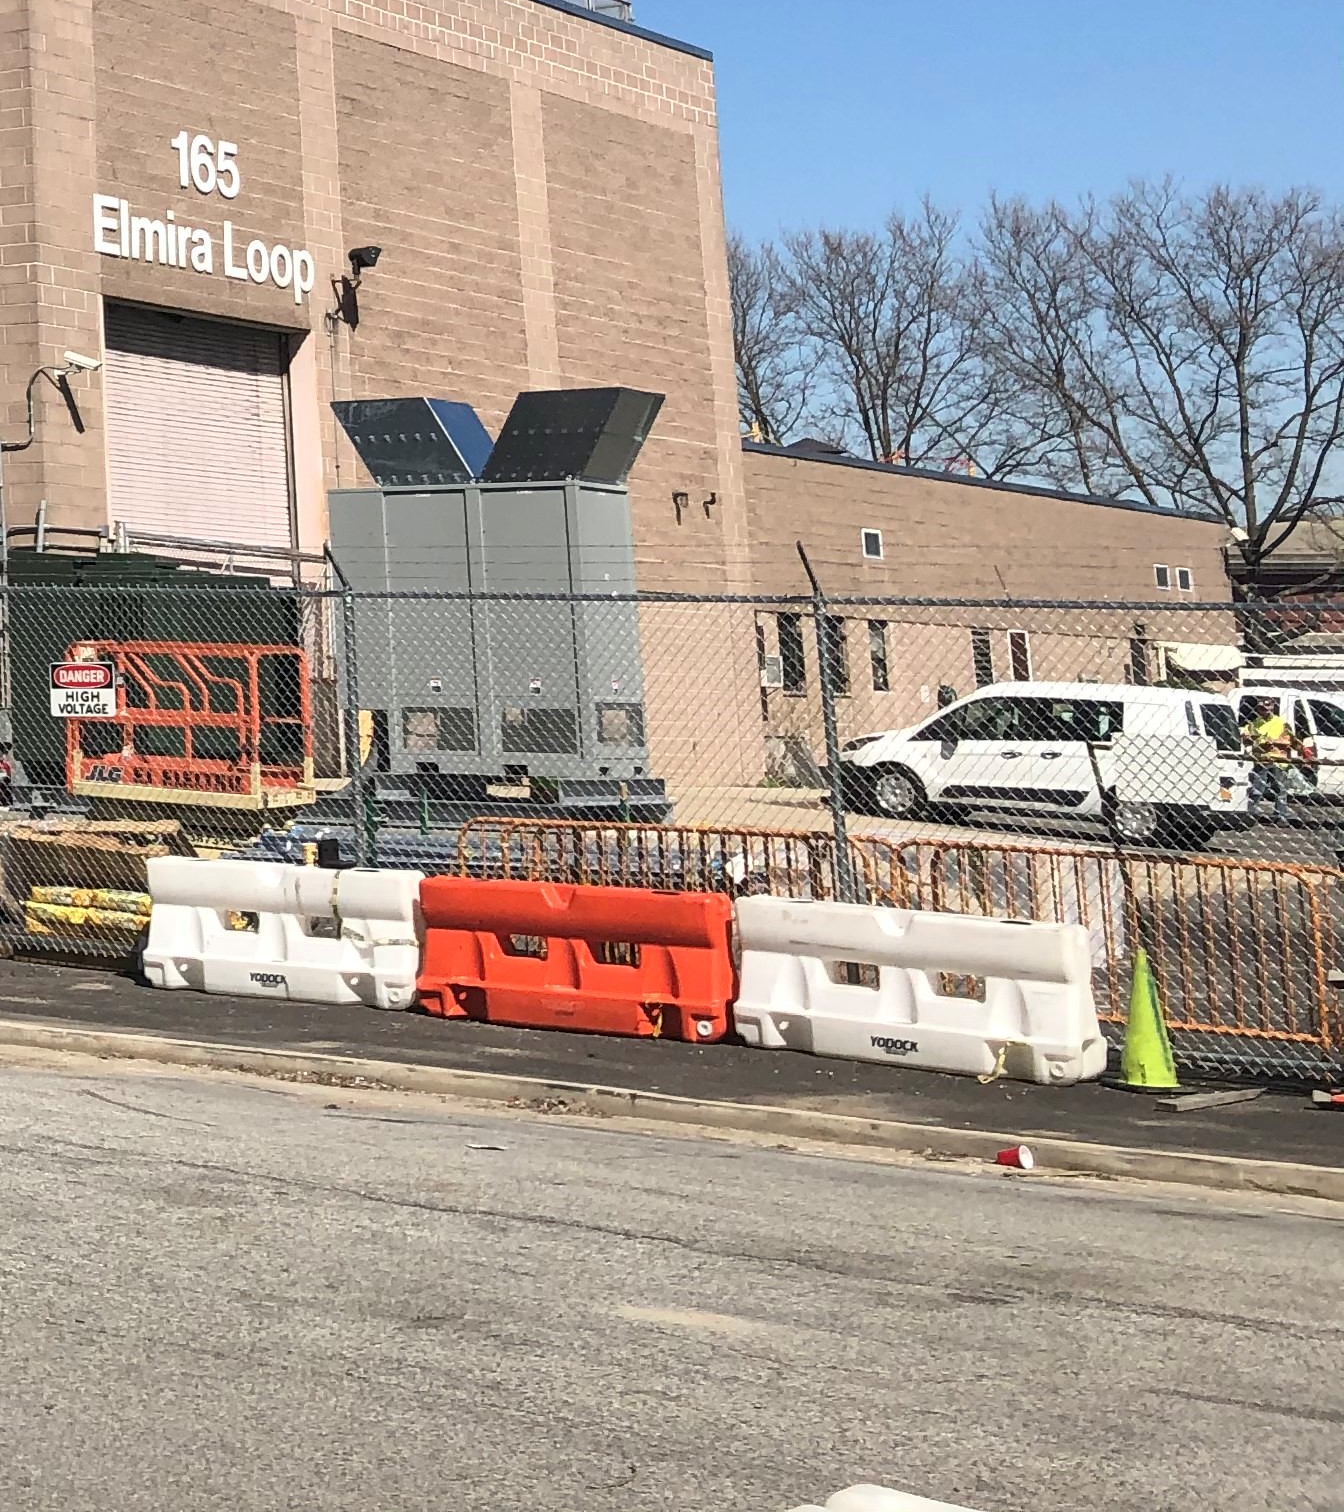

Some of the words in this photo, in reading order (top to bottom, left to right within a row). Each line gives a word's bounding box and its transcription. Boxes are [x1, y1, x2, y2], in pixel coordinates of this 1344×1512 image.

[171, 130, 240, 199] 165
[92, 193, 213, 274] Elmira
[223, 220, 315, 304] Loop
[59, 669, 105, 683] DANGER
[65, 691, 100, 703] HIGH
[58, 703, 109, 715] VOLTAGE
[85, 764, 123, 783] JLG
[870, 1035, 919, 1053] YODOCK
